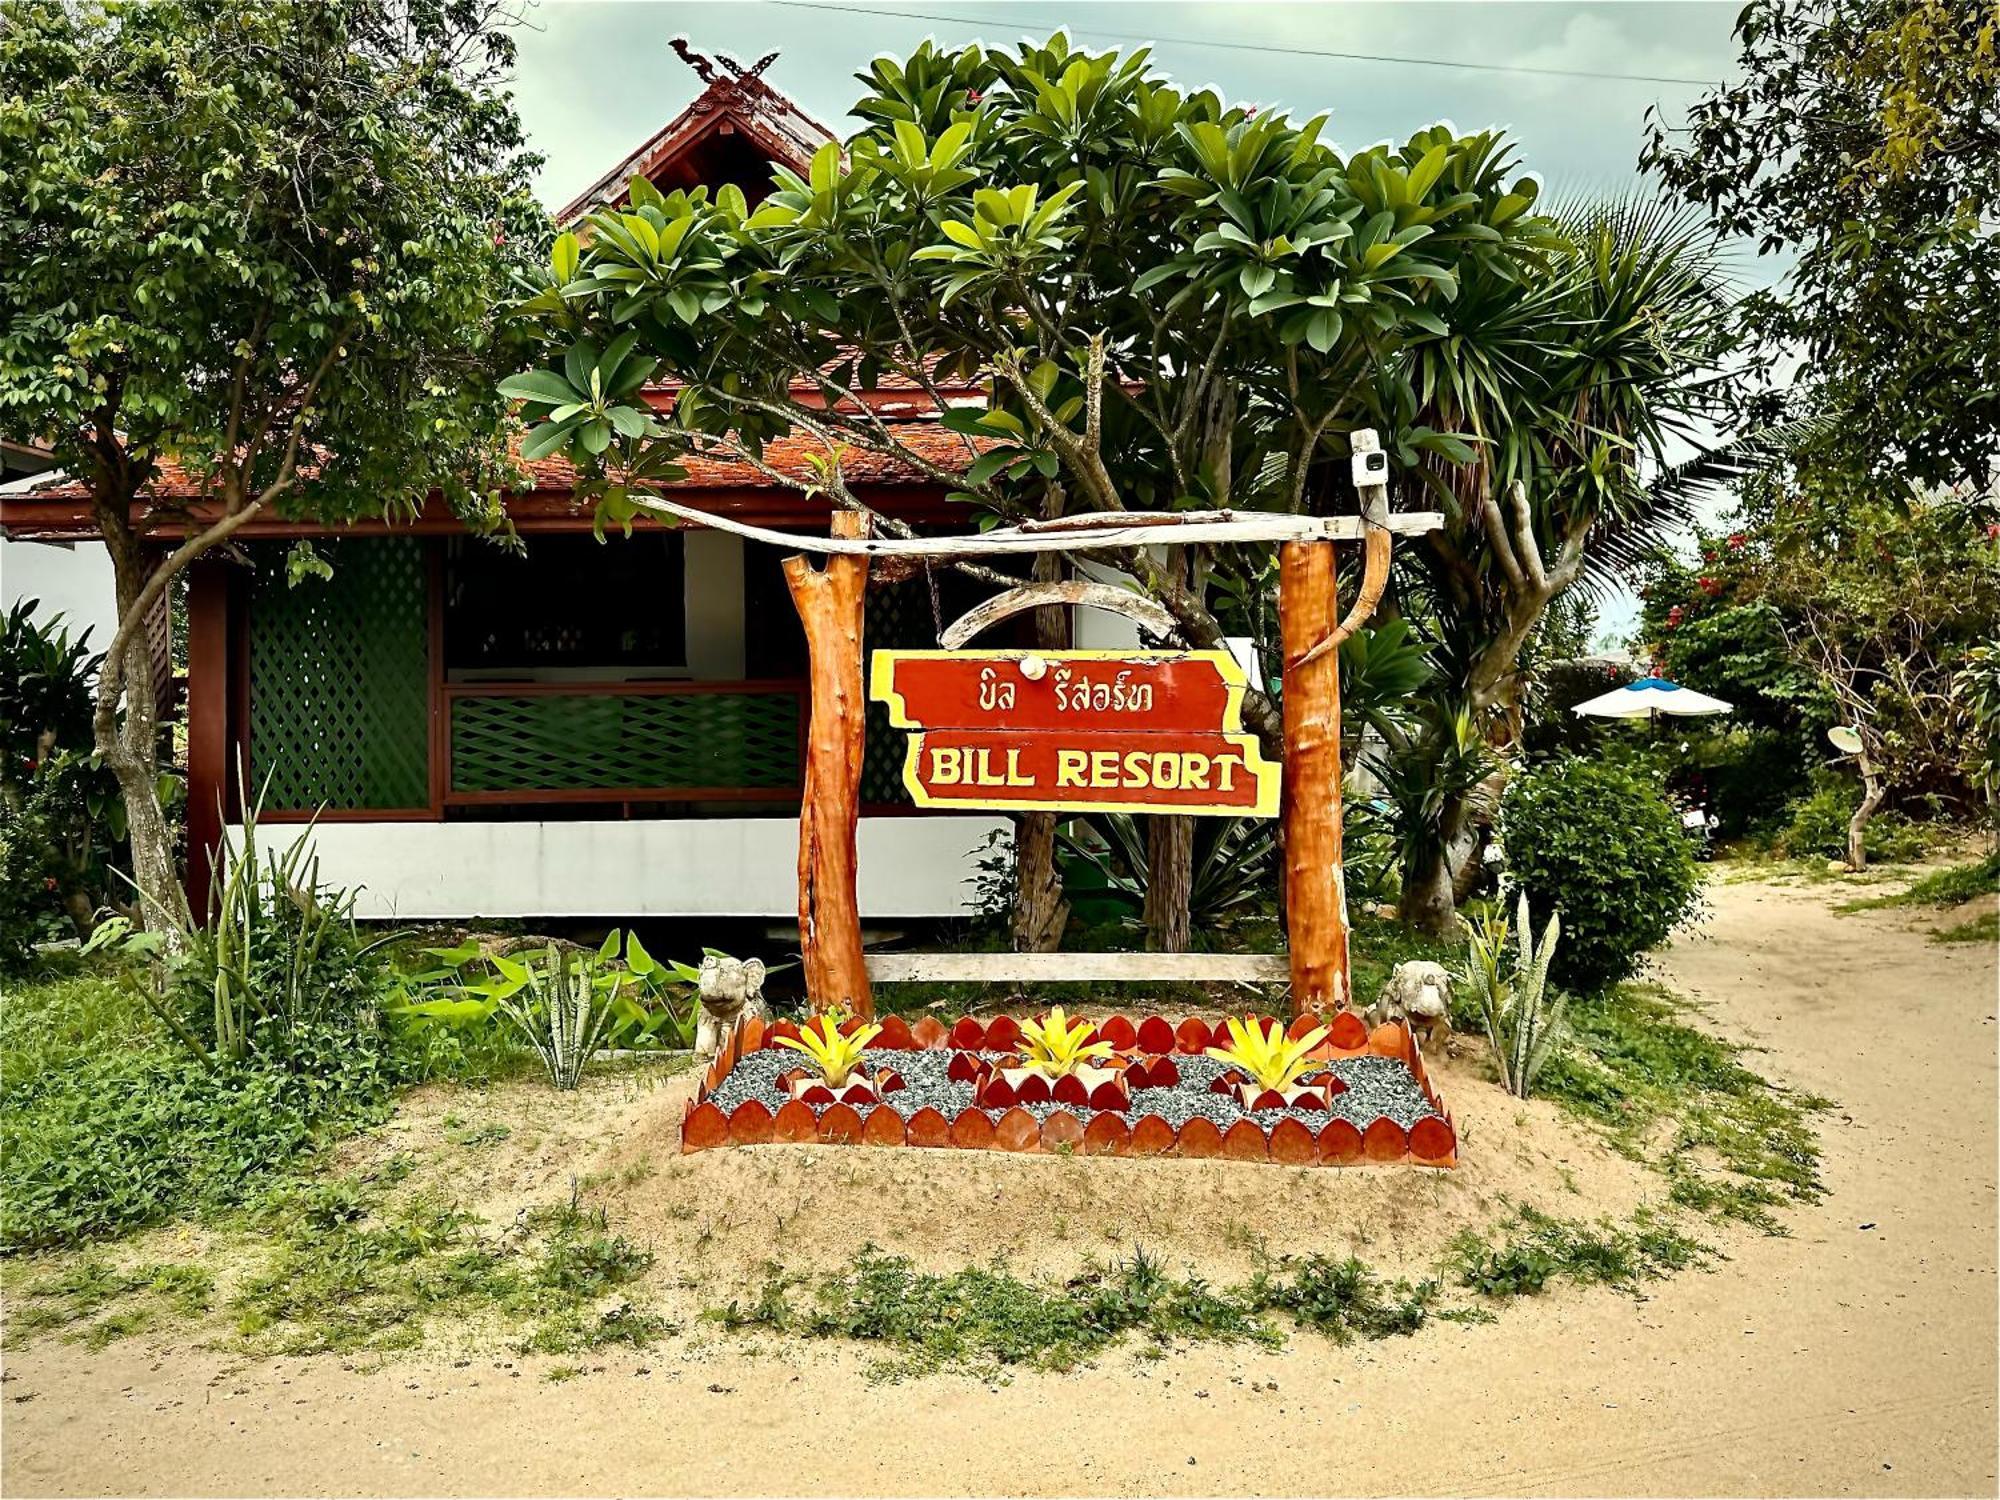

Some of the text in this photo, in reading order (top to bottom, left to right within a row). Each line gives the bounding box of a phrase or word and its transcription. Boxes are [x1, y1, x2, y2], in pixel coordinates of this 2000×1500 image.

[979, 667, 1016, 711] บิล
[929, 748, 1243, 791] BILL RESORT
